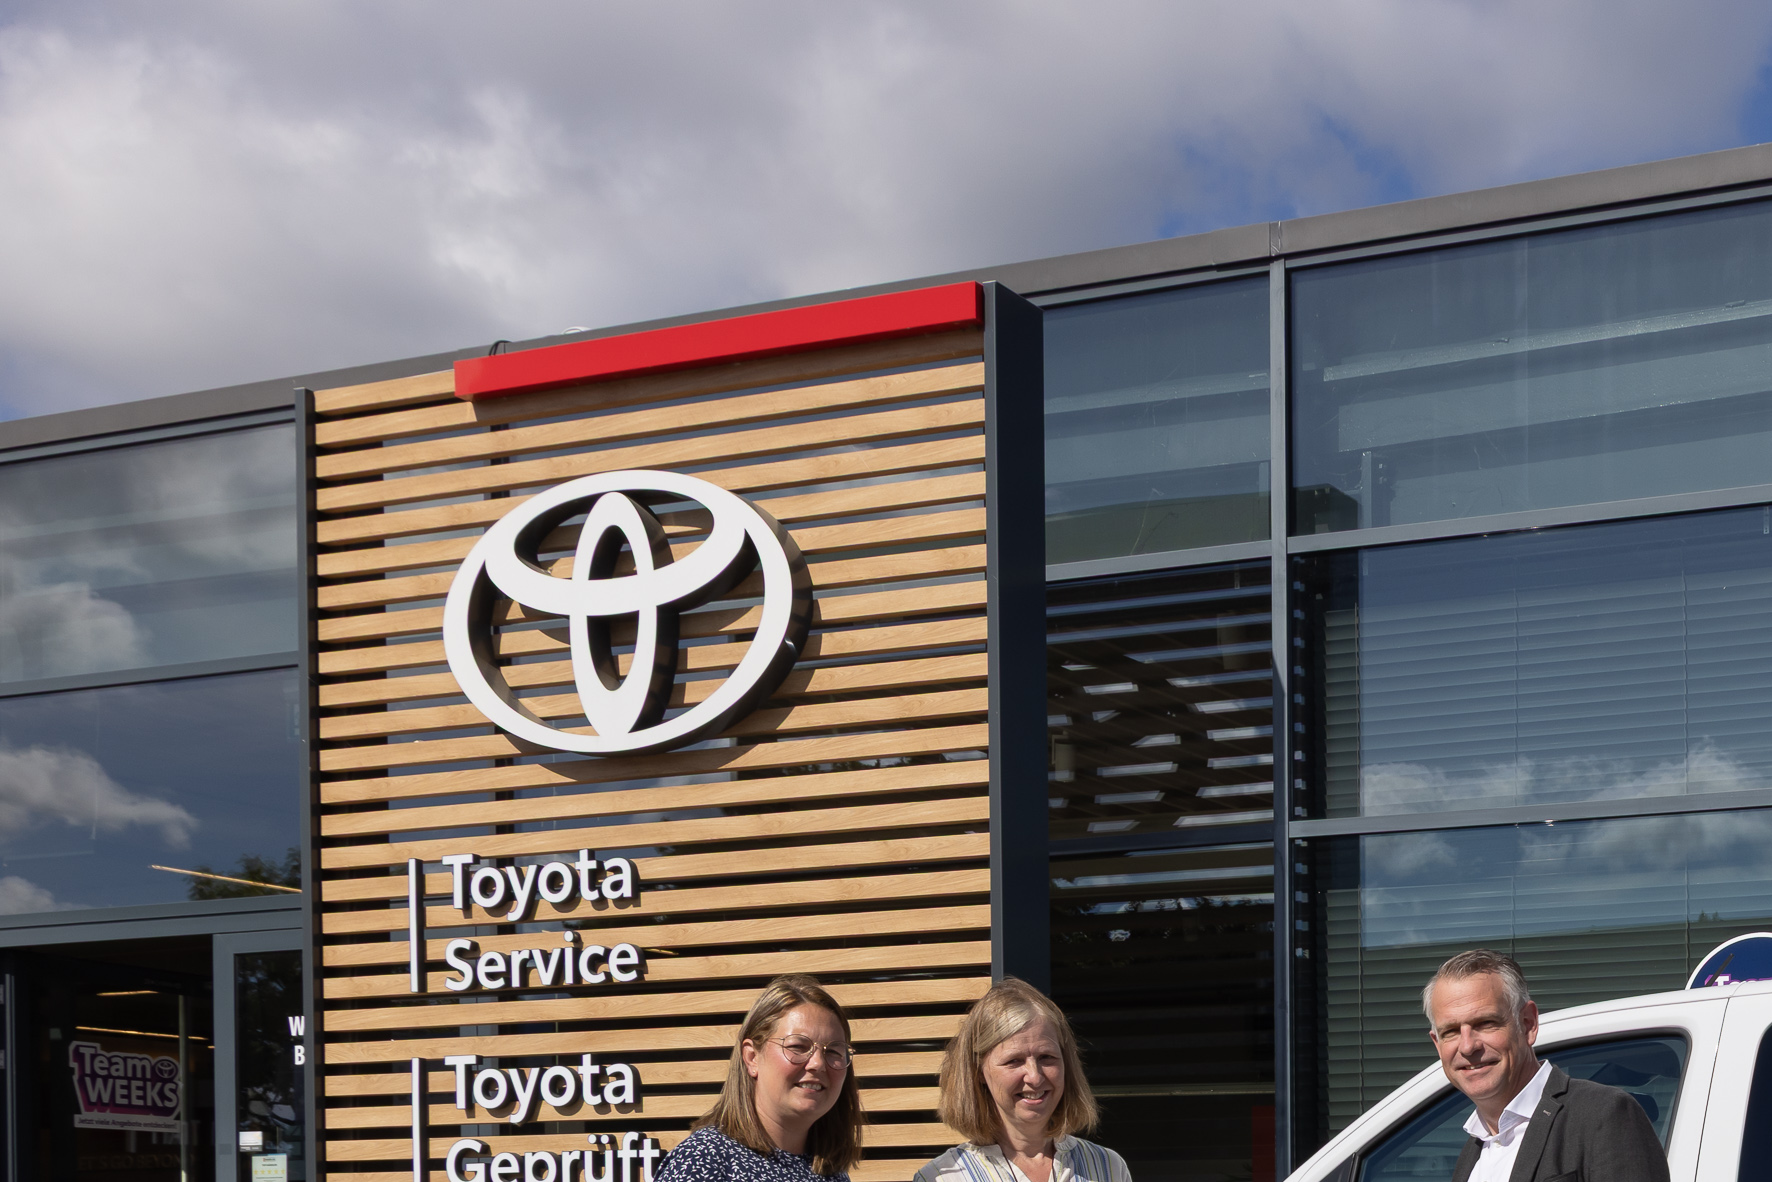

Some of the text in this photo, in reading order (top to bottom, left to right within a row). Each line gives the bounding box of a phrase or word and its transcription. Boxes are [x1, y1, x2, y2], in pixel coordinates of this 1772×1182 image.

[442, 848, 633, 921] Toyota
[443, 931, 641, 991] Service
[78, 1046, 152, 1079] Team
[84, 1076, 178, 1108] WEEKS
[445, 1053, 636, 1123] Toyota
[111, 1119, 142, 1128] Angebote
